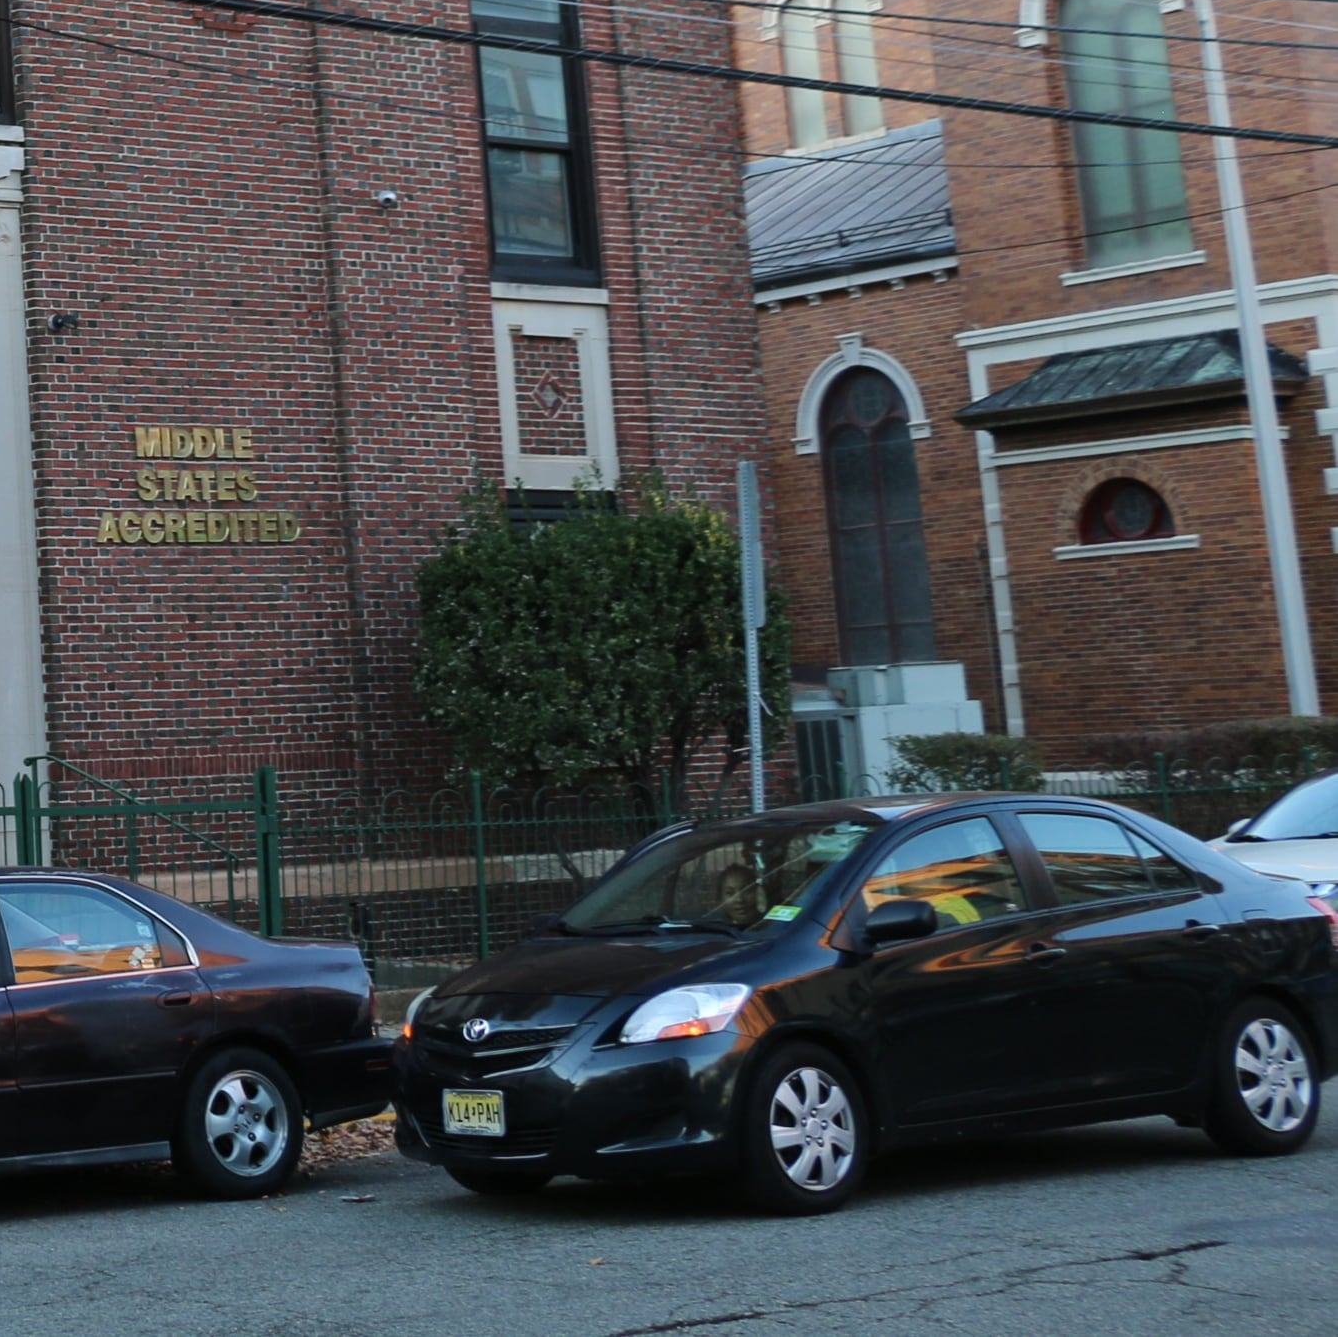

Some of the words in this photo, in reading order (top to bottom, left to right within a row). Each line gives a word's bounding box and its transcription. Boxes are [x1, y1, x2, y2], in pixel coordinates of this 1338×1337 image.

[134, 426, 254, 459] MIDDLE
[136, 469, 258, 501] STATES
[97, 511, 301, 543] ACCREDITED
